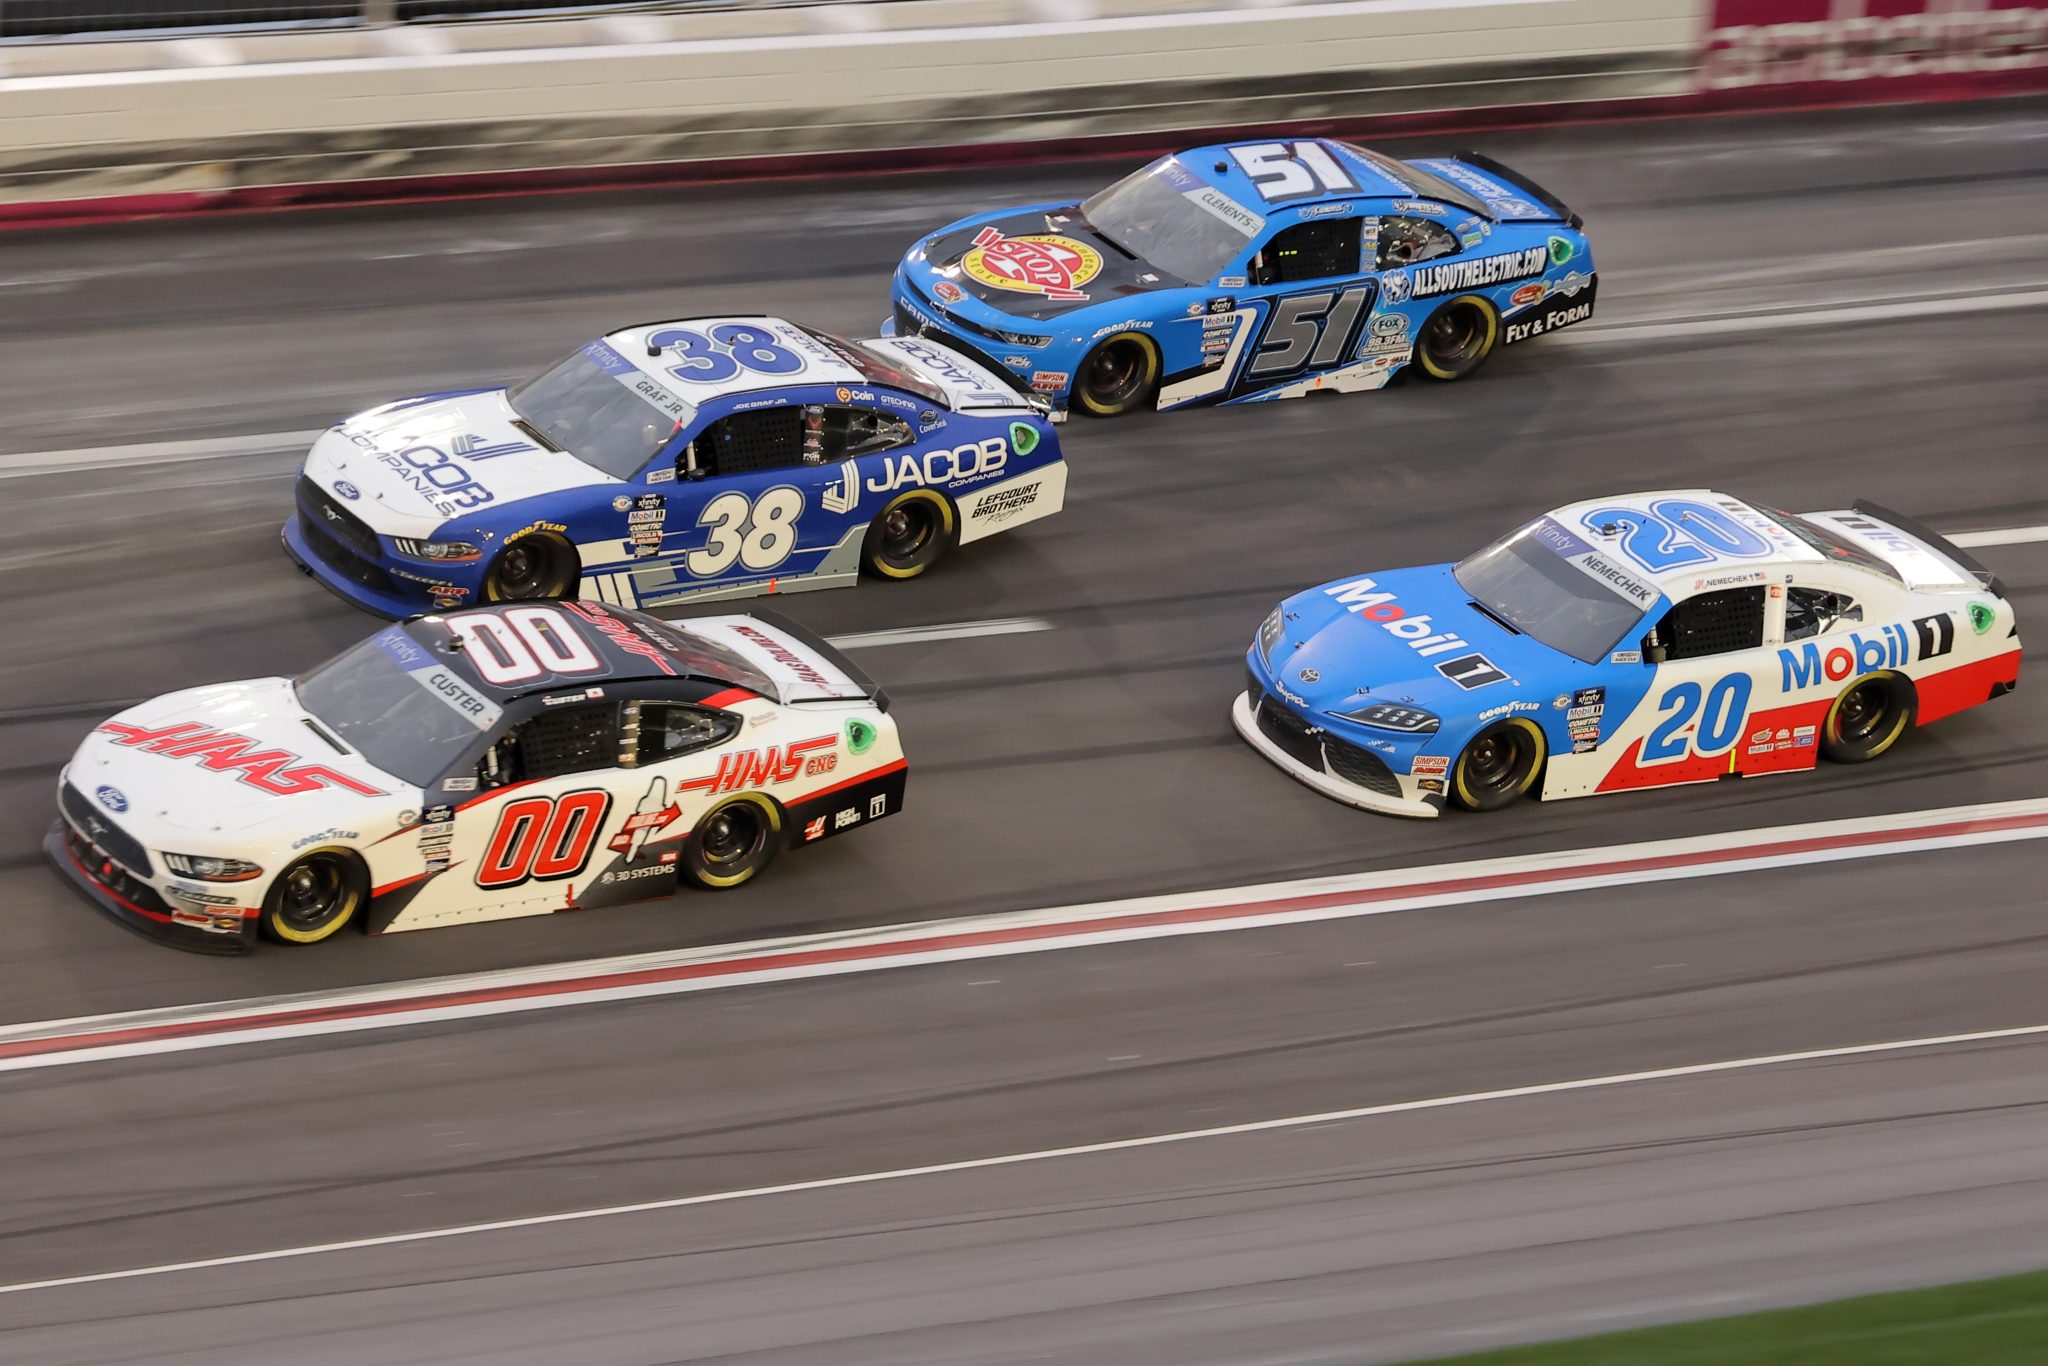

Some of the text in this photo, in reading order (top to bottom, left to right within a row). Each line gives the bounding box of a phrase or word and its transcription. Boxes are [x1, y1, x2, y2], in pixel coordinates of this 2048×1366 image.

[1226, 141, 1358, 201] 51
[1202, 193, 1251, 226] CLEMENTS
[994, 242, 1062, 284] STOP
[1412, 247, 1547, 297] ALLSOUTHELECTRIC.COM
[1096, 319, 1153, 336] GOODYEAR
[1250, 288, 1366, 372] 51
[1379, 319, 1399, 329] FOX
[1506, 303, 1590, 343] FLY & FORM
[586, 343, 621, 369] xfinity
[645, 322, 808, 384] 38
[1036, 373, 1065, 381] SIMPSON
[635, 380, 684, 415] GRAF JR
[751, 400, 774, 408] GRAF
[852, 390, 874, 401] Coin
[919, 419, 948, 434] CoverSeal
[867, 437, 1008, 494] JACOB
[949, 469, 1005, 488] COMPANIES
[638, 498, 661, 508] xfinity
[971, 493, 1038, 518] BROTHERS
[977, 482, 1042, 507] LEFCOURT
[631, 511, 654, 520] Mobil
[502, 520, 568, 545] GOODYEAR
[684, 484, 806, 578] 38
[1535, 521, 1575, 551] xfinity
[1580, 499, 1775, 573] 20
[1582, 554, 1649, 601] NEMECHEK
[1707, 575, 1747, 586] NEMECHEK
[1323, 577, 1470, 657] Mobil
[382, 632, 419, 664] xfinity
[445, 606, 602, 683] 00
[1777, 623, 1909, 693] Mobil
[429, 673, 486, 716] CUSTER
[1578, 694, 1600, 703] xfinity
[1479, 701, 1540, 720] GOODYEAR
[1569, 706, 1592, 717] Mobil
[1642, 672, 1752, 761] 20
[1570, 727, 1595, 735] LINCOLN
[92, 722, 392, 797] HAAS
[676, 733, 840, 796] HAAS
[805, 752, 838, 777] CNC
[1415, 757, 1447, 765] SIMPSON
[98, 787, 127, 811] Ford
[292, 828, 359, 849] GOODYEAR
[475, 787, 613, 890] 00
[616, 864, 676, 881] 3D SYSTEMS
